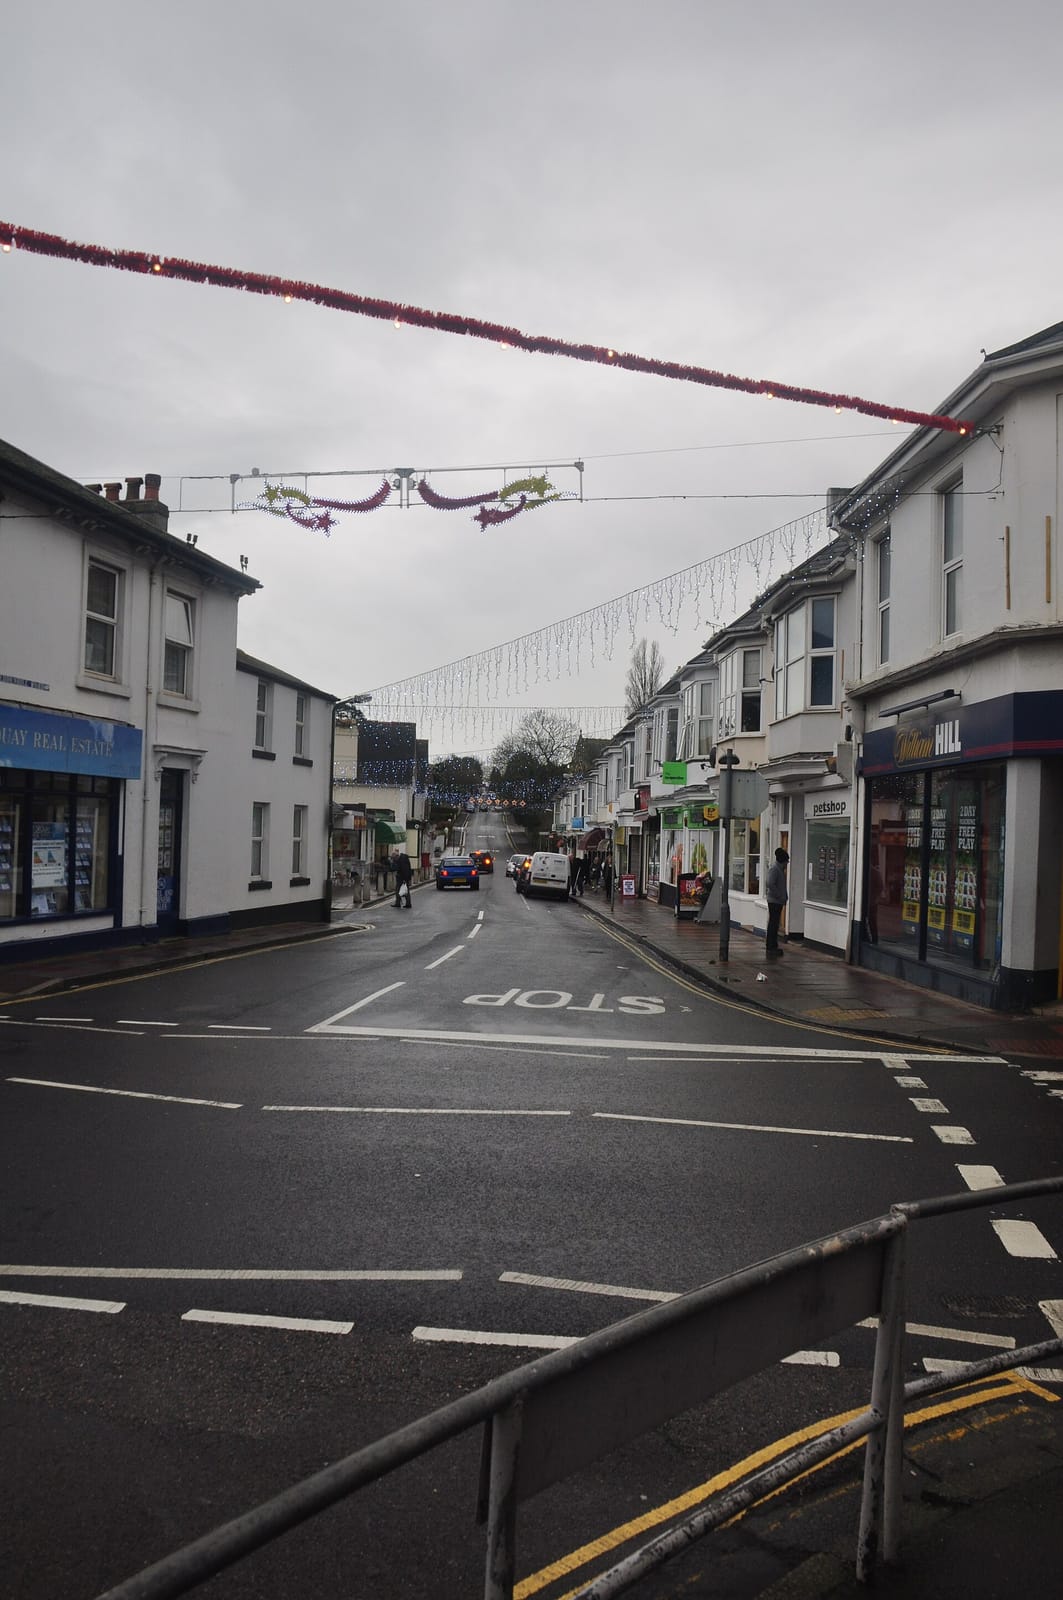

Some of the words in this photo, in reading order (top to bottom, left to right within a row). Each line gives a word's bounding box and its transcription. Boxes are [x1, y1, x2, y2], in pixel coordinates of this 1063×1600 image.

[33, 731, 66, 752] REAL
[71, 737, 113, 758] ESTATE
[895, 727, 934, 763] William
[935, 719, 962, 756] HILL
[813, 800, 846, 816] petshop
[964, 806, 976, 816] DAY
[907, 827, 920, 837] FREE
[931, 828, 946, 838] FREE
[959, 826, 976, 837] FREE
[931, 839, 945, 850] PLAY
[958, 837, 975, 850] PLAY
[462, 988, 666, 1014] STOP
